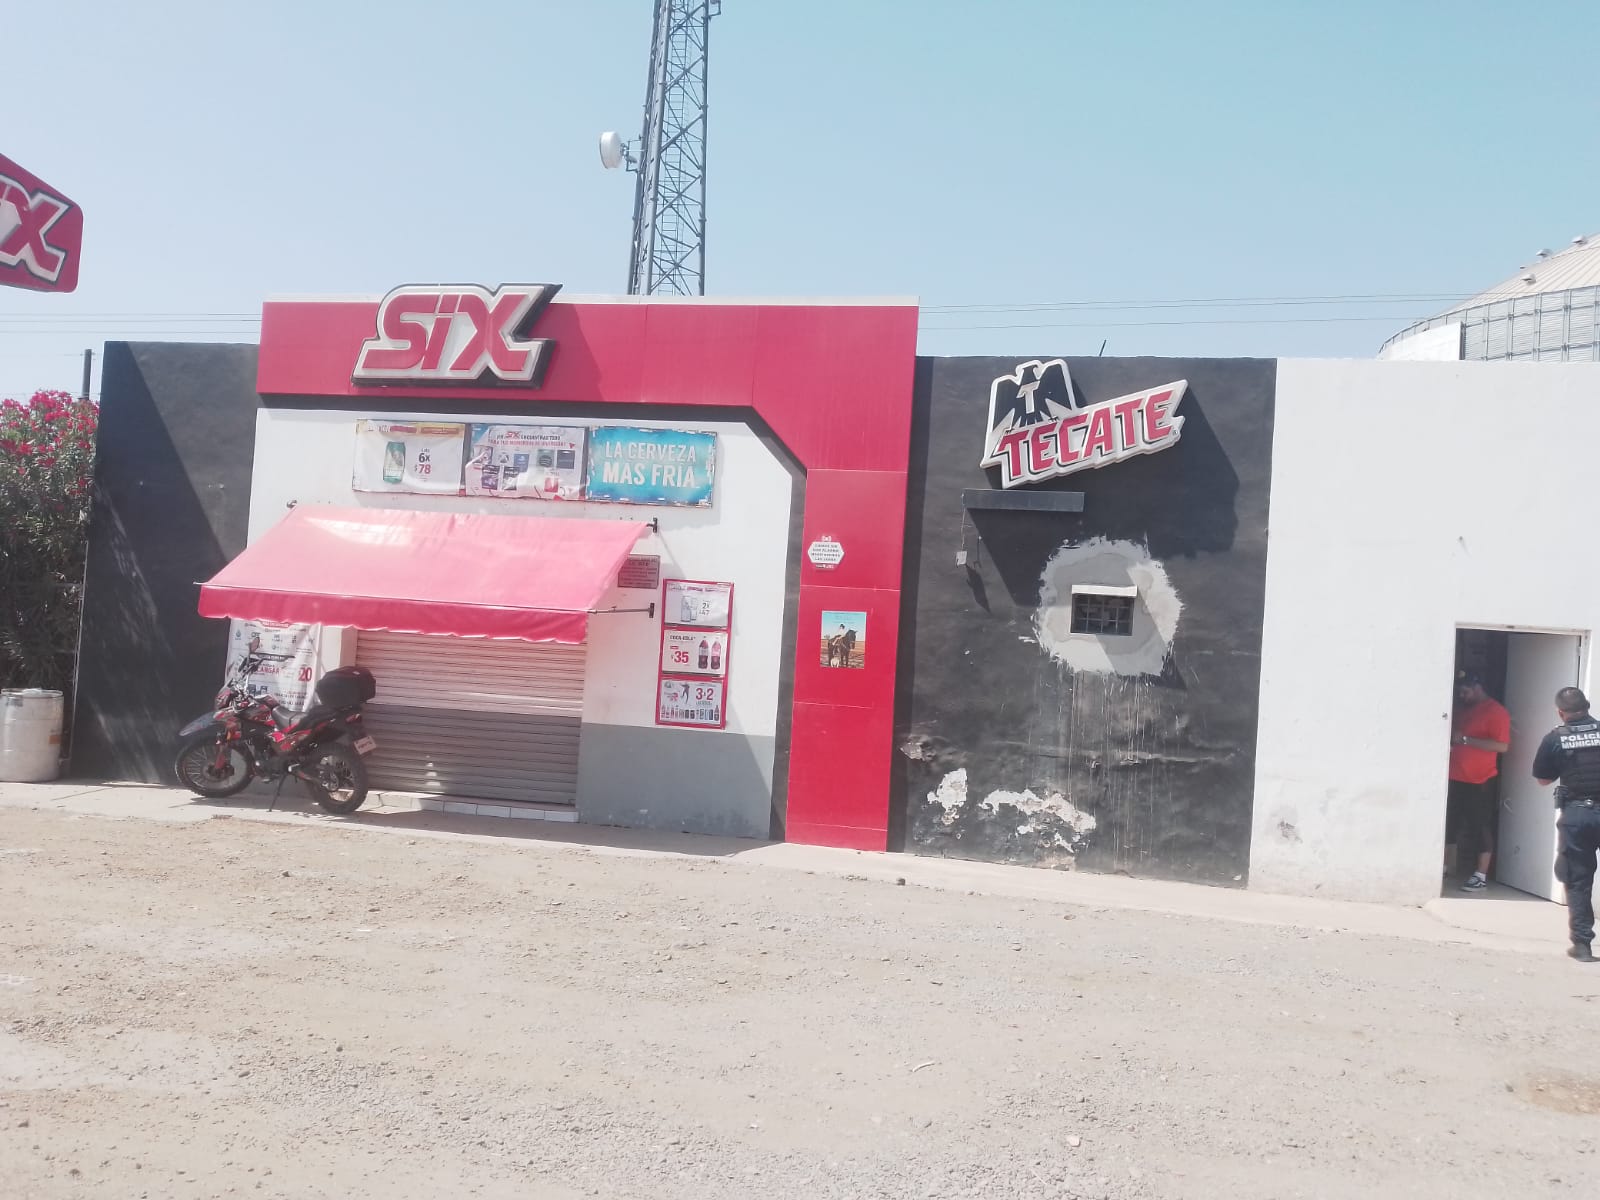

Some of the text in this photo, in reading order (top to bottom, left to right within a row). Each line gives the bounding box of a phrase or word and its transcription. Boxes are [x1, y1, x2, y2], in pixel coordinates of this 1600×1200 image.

[993, 388, 1176, 481] TECATE
[605, 441, 696, 462] LA CERVEZA
[602, 461, 645, 485] MAS
[1560, 732, 1600, 742] POLICI
[1561, 739, 1600, 749] MUNICIP
